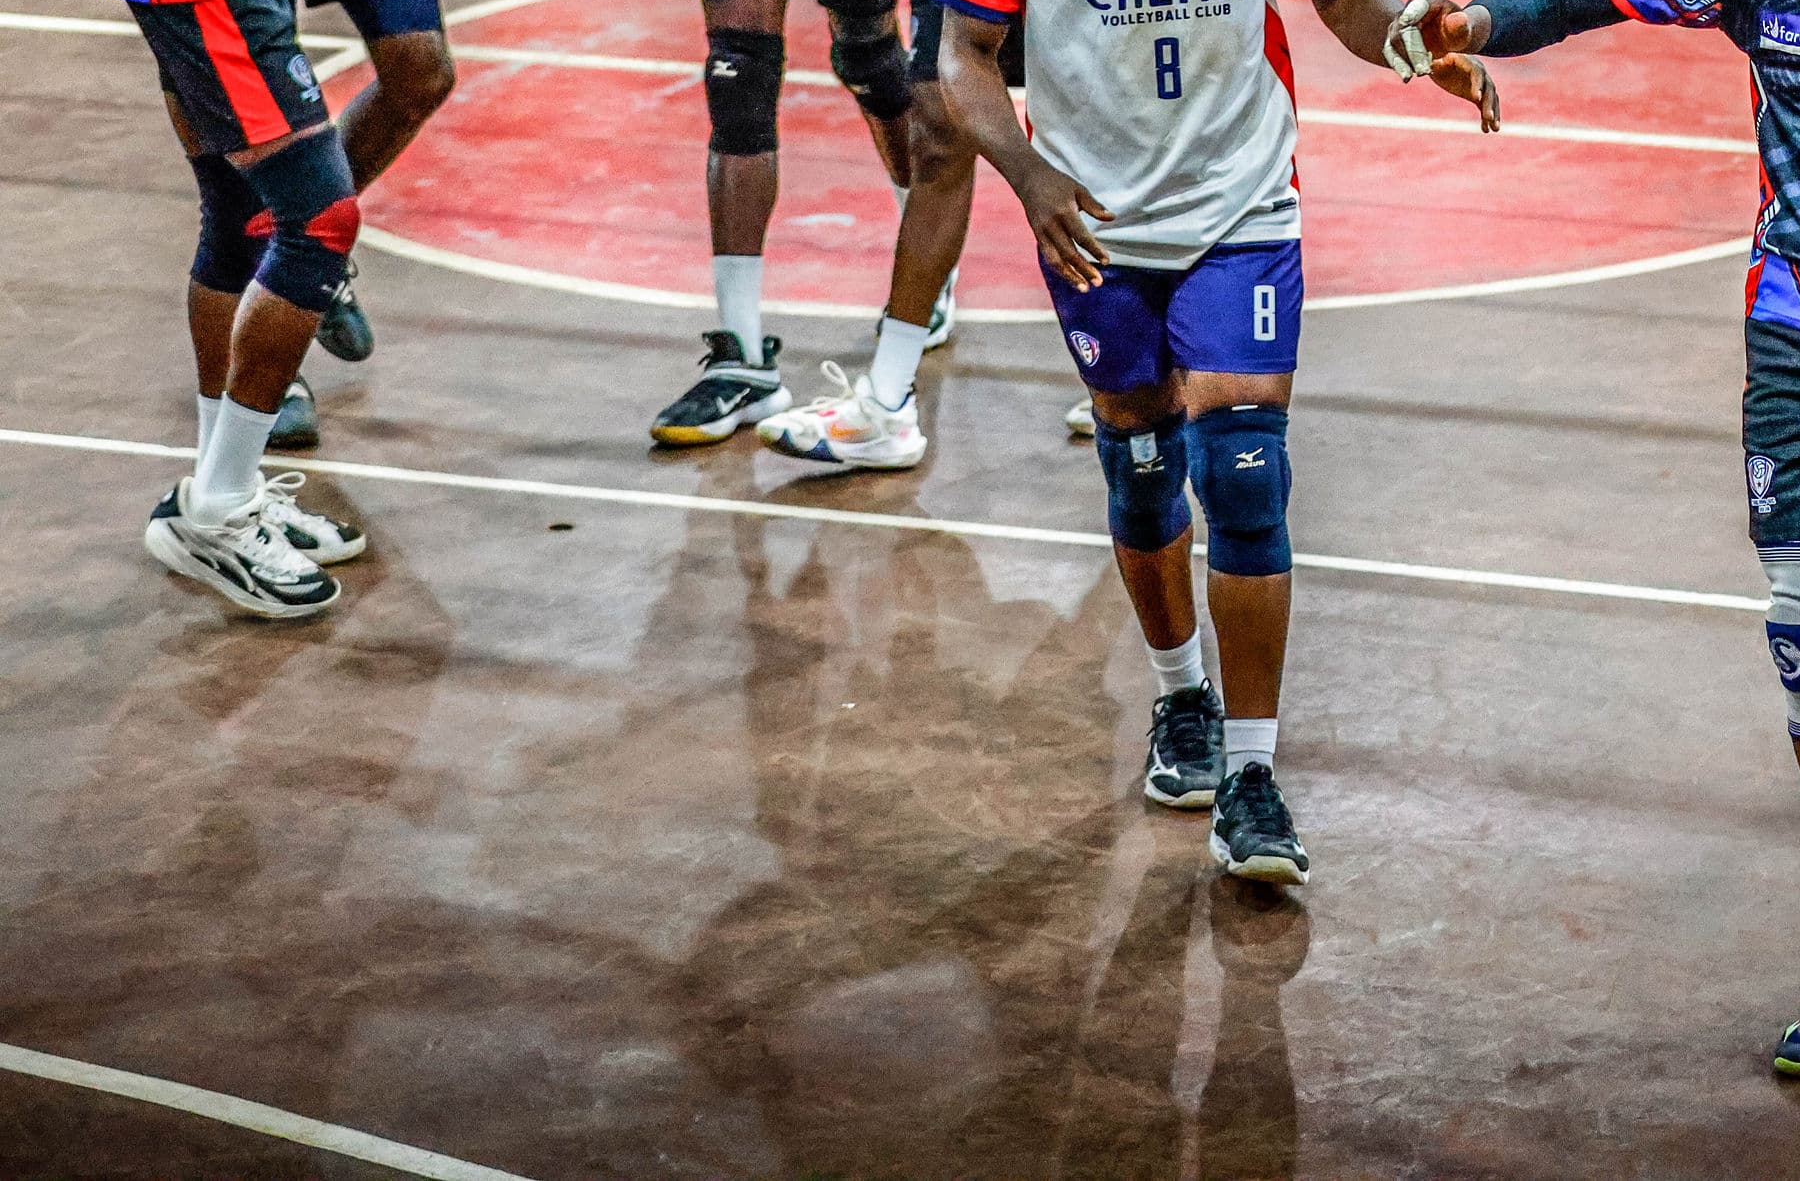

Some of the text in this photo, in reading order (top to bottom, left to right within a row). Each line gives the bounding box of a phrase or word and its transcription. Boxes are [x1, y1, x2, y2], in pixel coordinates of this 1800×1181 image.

[1101, 4, 1231, 26] VOLLEYBALL CLUB
[1154, 37, 1182, 100] 8
[1253, 284, 1276, 341] 8
